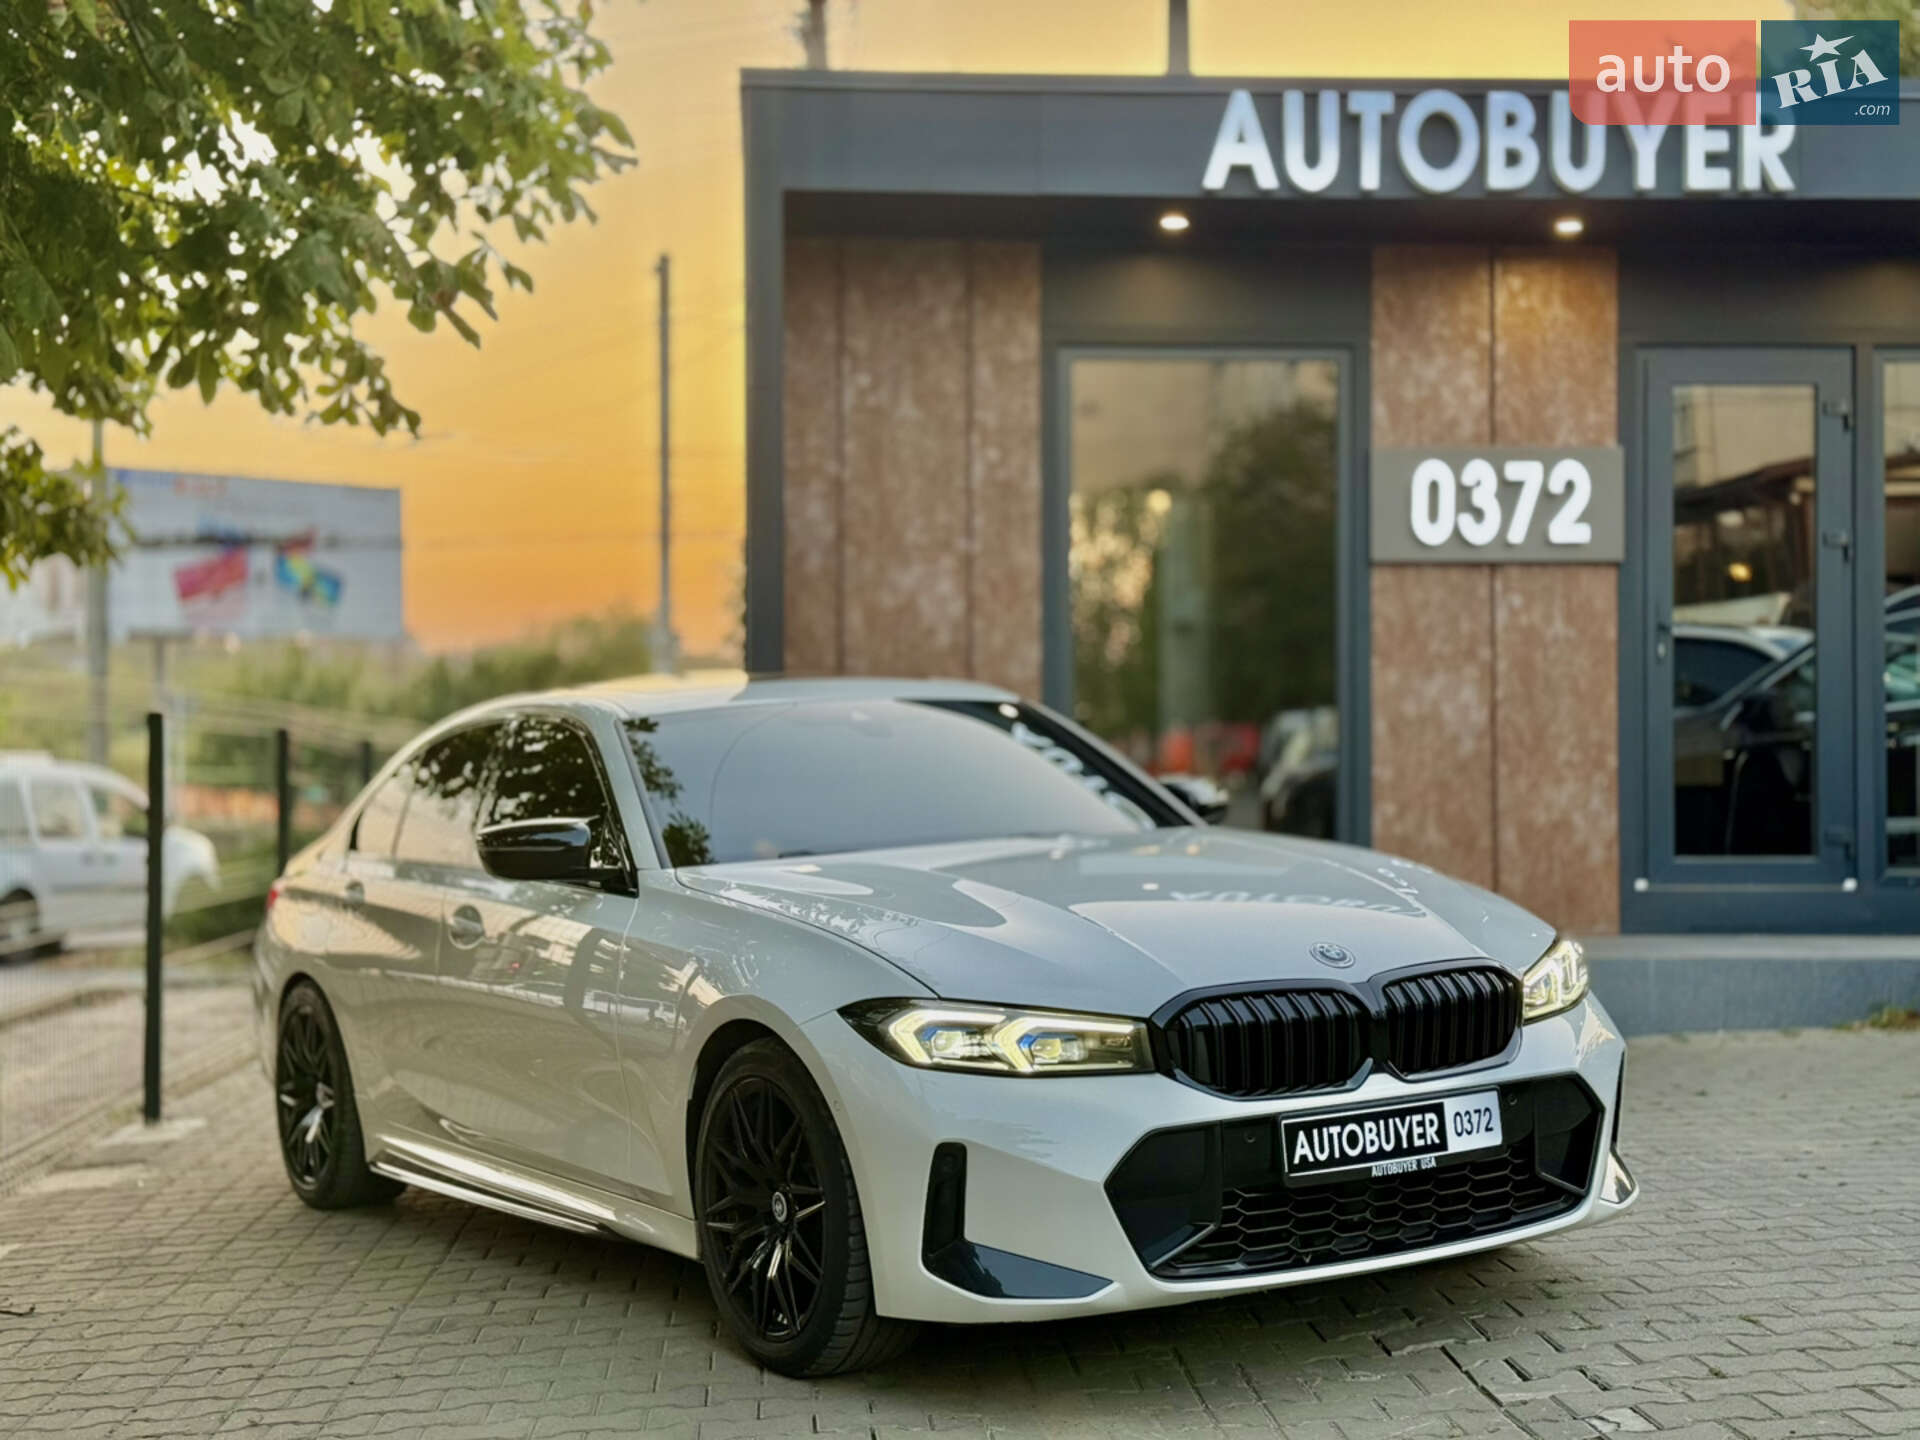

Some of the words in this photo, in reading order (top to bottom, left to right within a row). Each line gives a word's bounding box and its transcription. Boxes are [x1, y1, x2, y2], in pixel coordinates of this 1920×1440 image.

[1202, 89, 1796, 193] AUTOBUYER
[1410, 458, 1592, 546] 0372
[1293, 1112, 1441, 1165] AUTOBUYER
[1453, 1107, 1494, 1137] 0372
[1371, 1159, 1418, 1177] AUTOBUYER
[1421, 1156, 1437, 1170] USA
